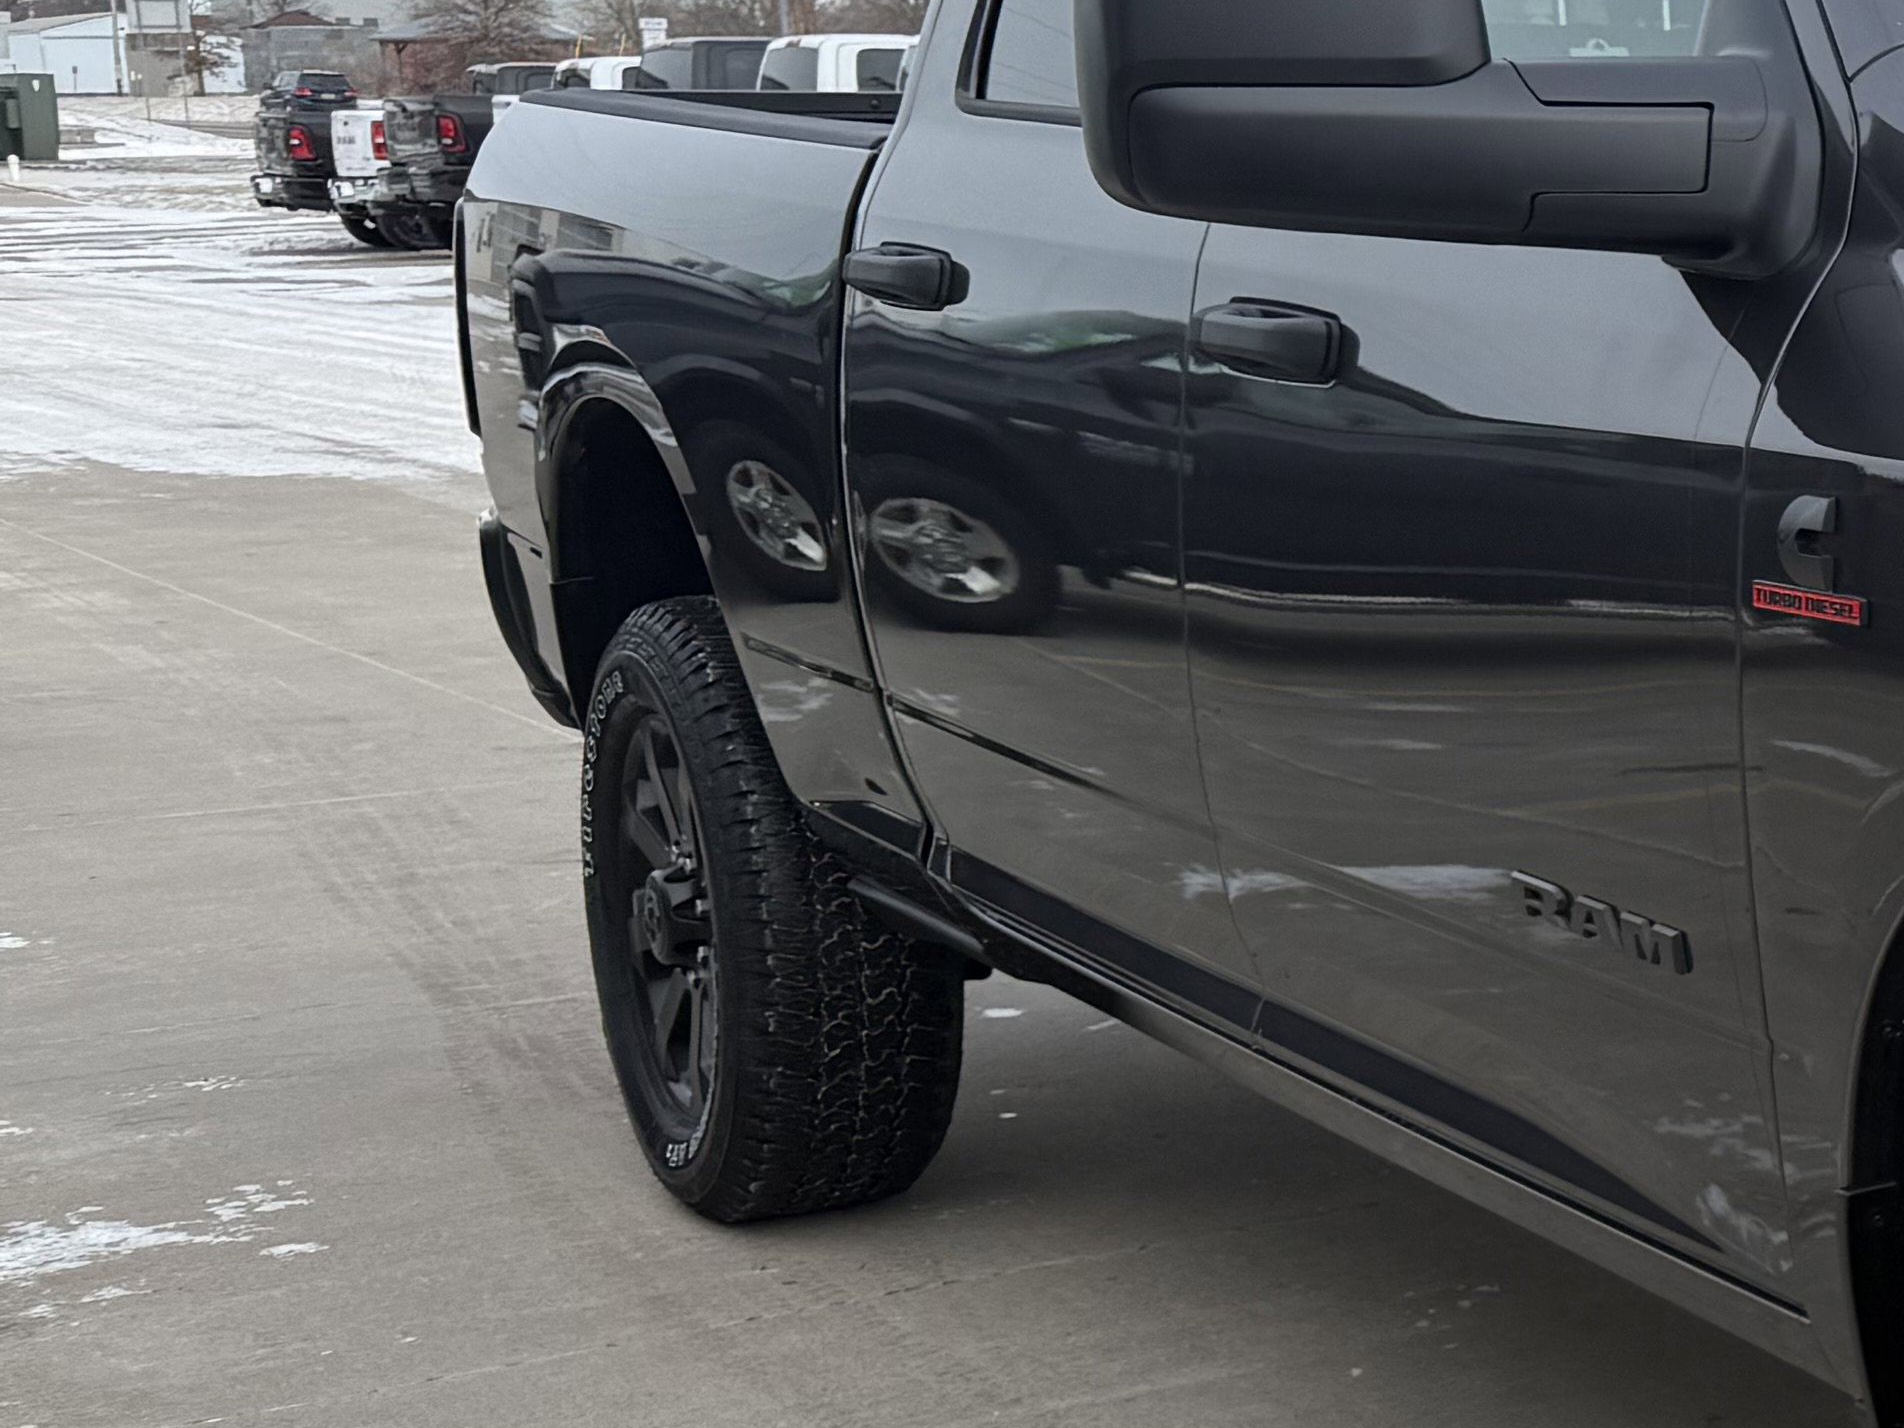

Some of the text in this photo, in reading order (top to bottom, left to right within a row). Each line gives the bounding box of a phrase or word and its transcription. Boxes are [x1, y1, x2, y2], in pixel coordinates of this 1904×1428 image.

[1755, 587, 1861, 621] TURBO DIESEL
[1510, 869, 1694, 976] RAM
